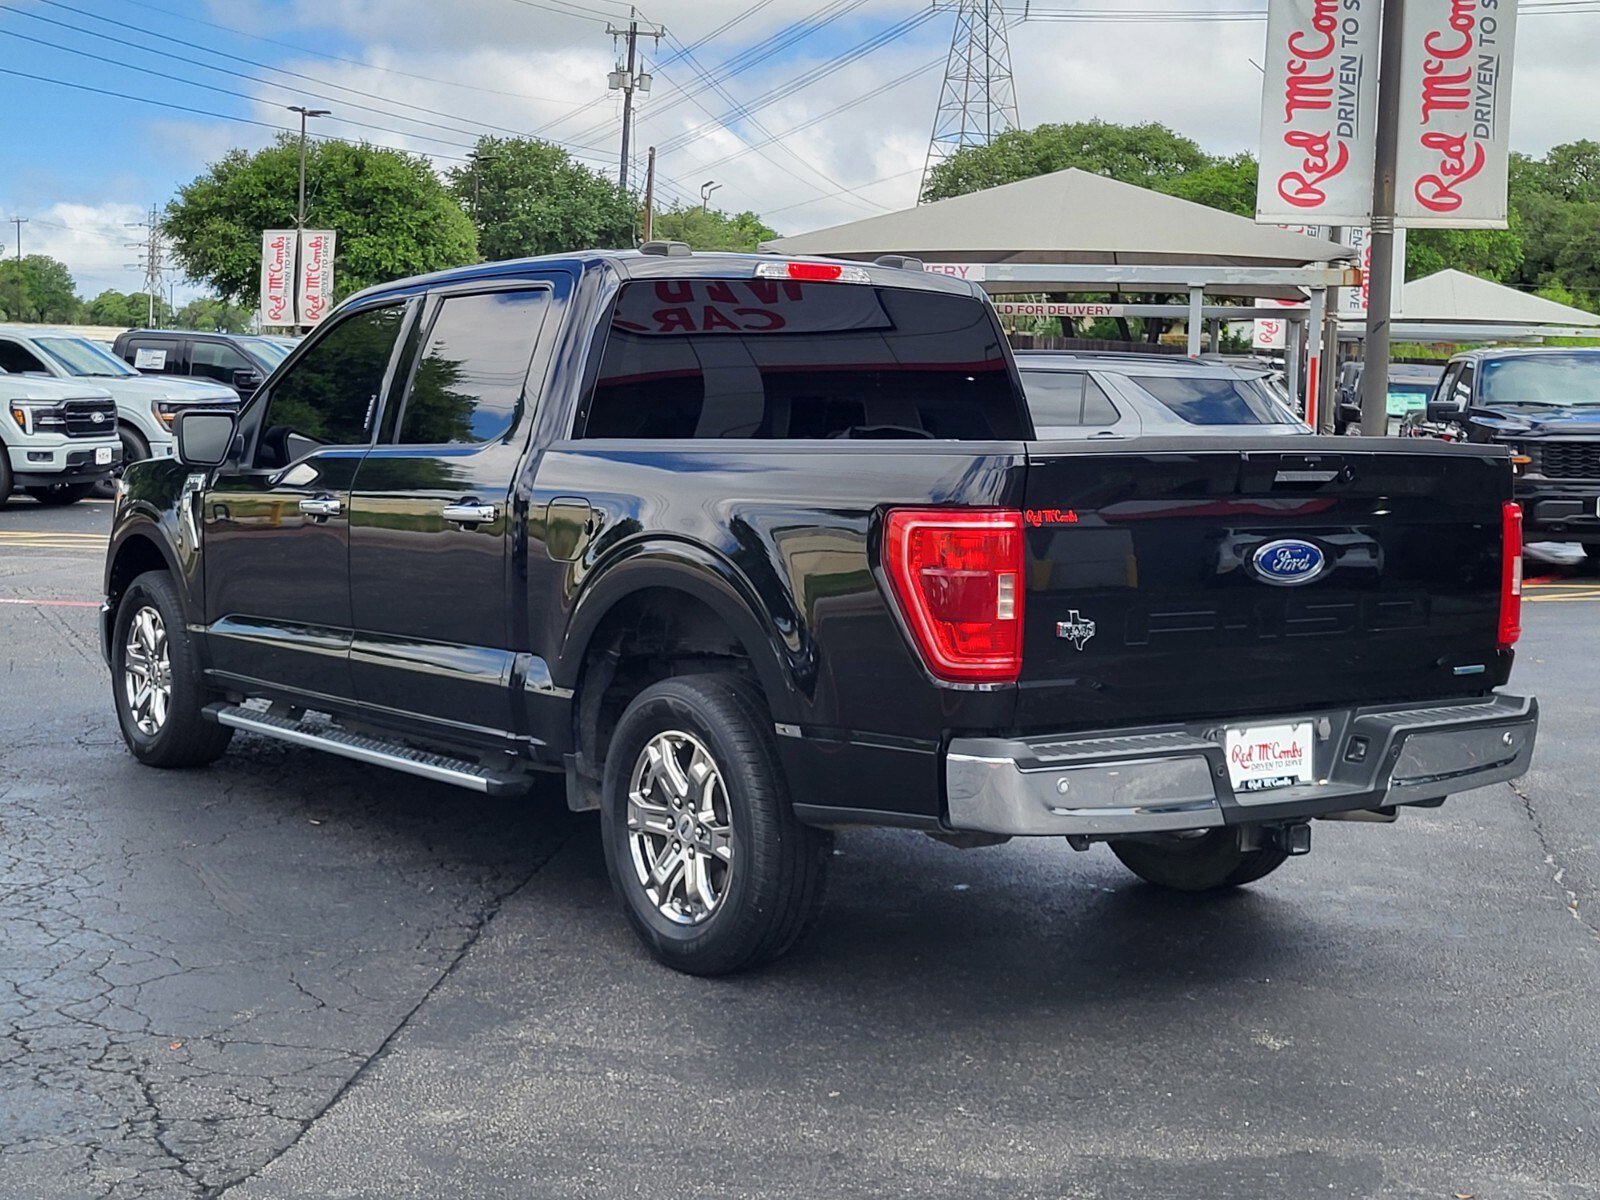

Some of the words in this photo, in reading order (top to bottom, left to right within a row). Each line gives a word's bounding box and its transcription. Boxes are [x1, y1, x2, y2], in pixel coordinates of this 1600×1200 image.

[1341, 17, 1360, 48] TO
[1479, 16, 1498, 48] TO
[1337, 54, 1358, 139] DRIVEN
[1473, 55, 1496, 140] DRIVEN
[1277, 130, 1349, 208] Red
[1414, 131, 1486, 212] Red
[268, 236, 285, 293] McCombs
[285, 259, 291, 269] TO
[306, 236, 323, 292] McCombs
[322, 259, 329, 269] TO
[268, 295, 286, 320] Red
[305, 295, 325, 320] Red
[1017, 305, 1045, 315] FOR
[1048, 305, 1113, 316] DELIVERY
[1025, 509, 1042, 527] Red
[1272, 547, 1310, 572] Ford
[1231, 744, 1254, 769] Red
[1255, 740, 1303, 761] McCombs
[1275, 760, 1284, 768] TO
